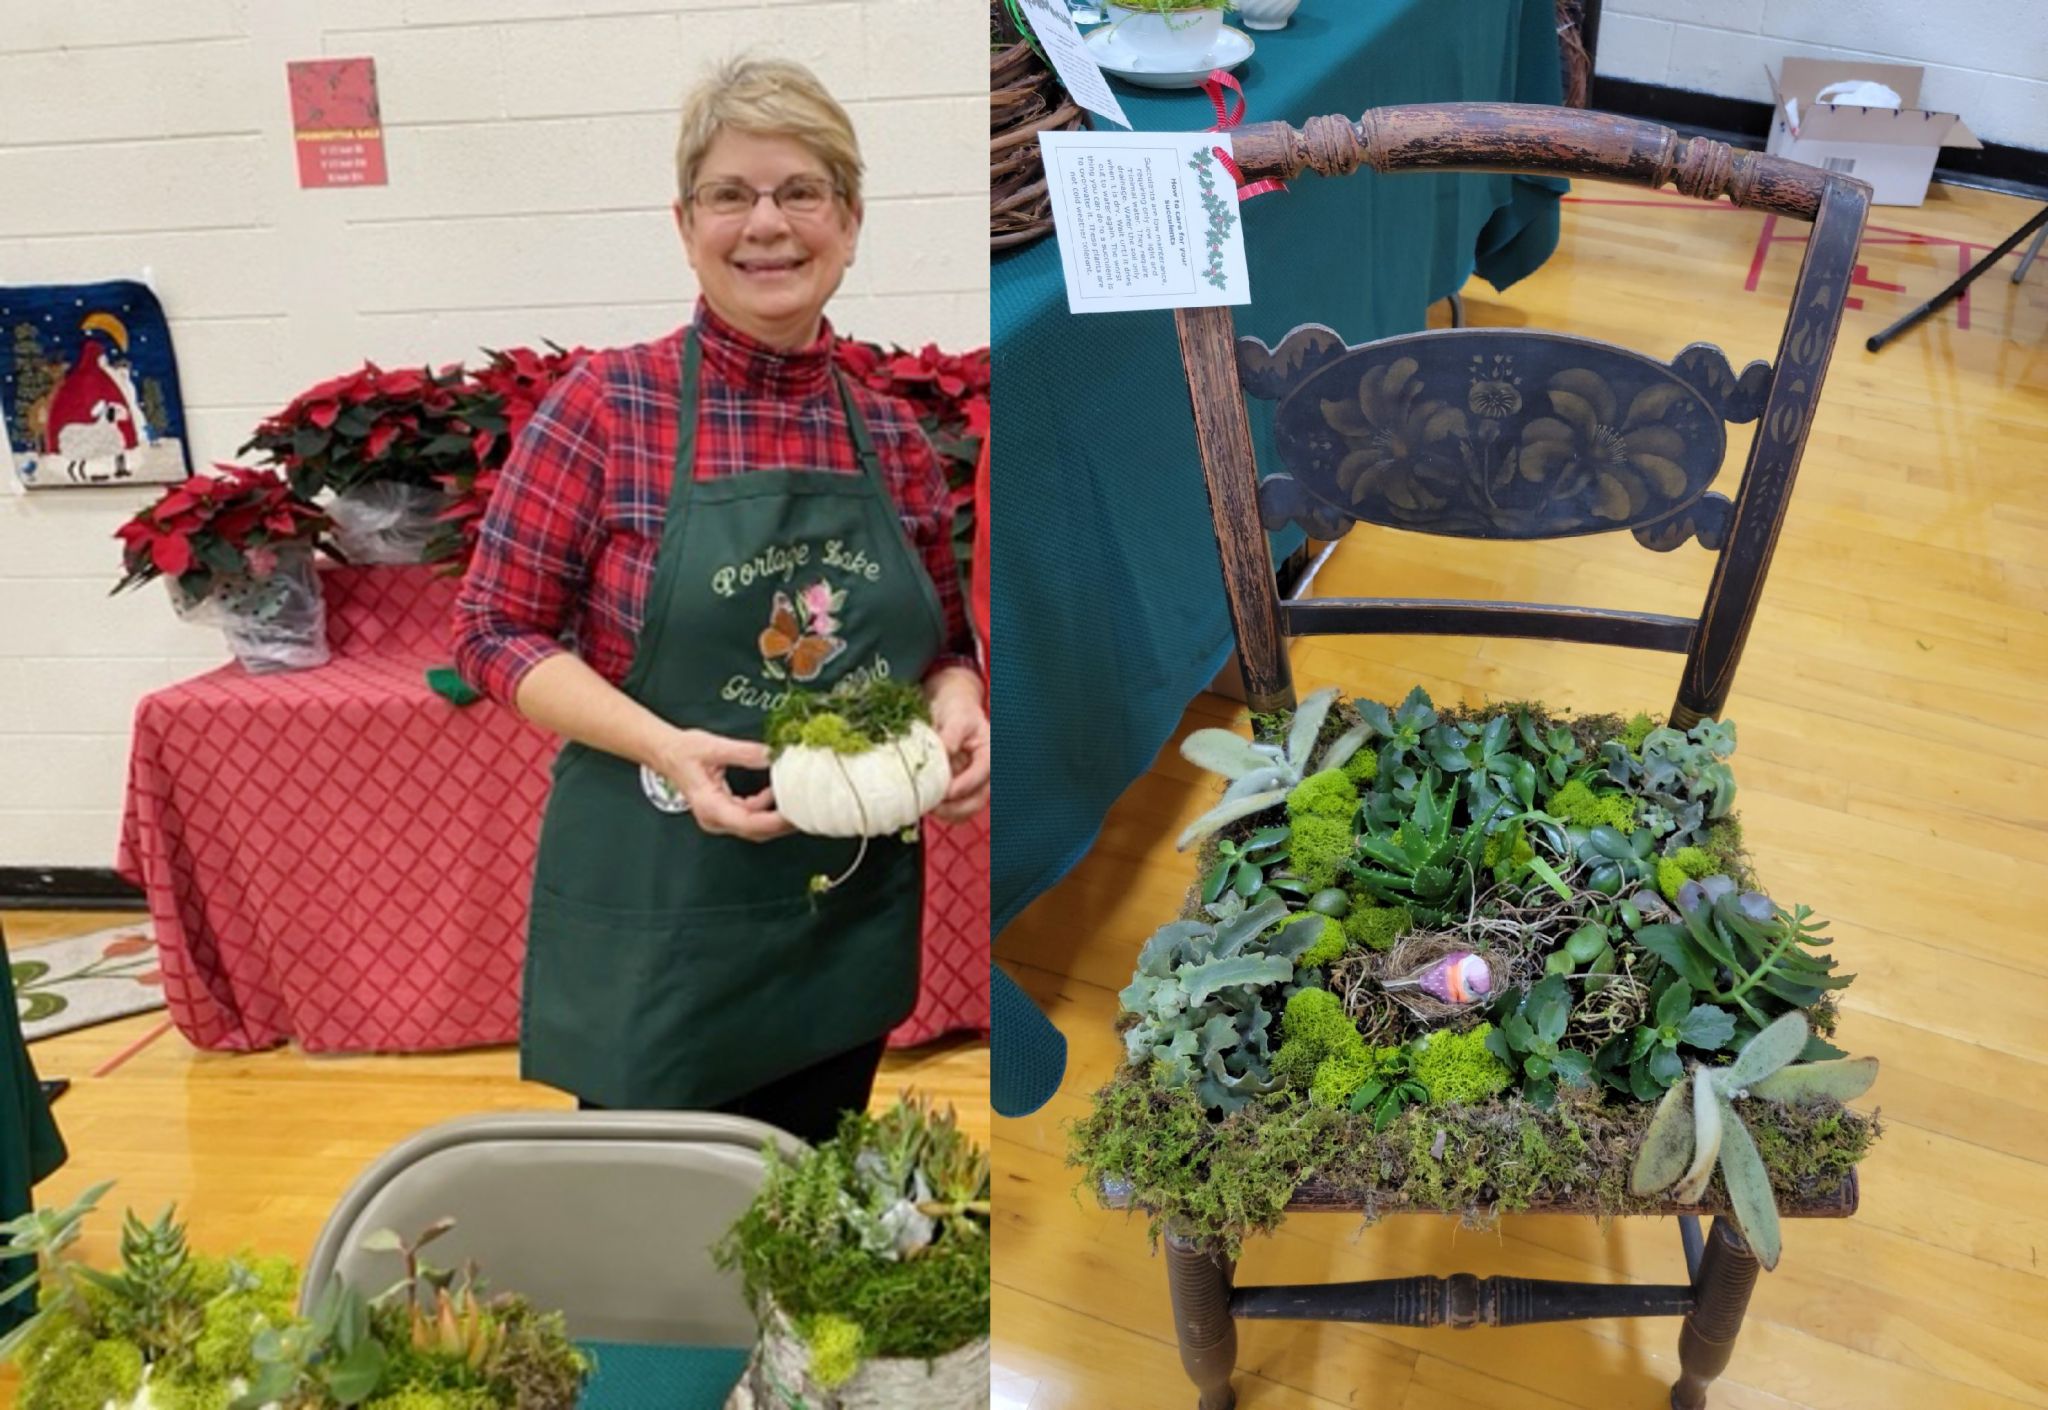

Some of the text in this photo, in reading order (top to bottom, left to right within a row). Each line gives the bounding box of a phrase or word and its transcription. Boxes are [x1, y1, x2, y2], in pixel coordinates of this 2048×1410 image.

[1135, 168, 1147, 204] requiring
[1079, 168, 1091, 209] overwater
[1091, 249, 1102, 273] plants
[1086, 155, 1095, 176] thing
[1100, 243, 1112, 280] succulent
[1102, 190, 1111, 214] water
[1113, 259, 1122, 281] worst
[1106, 159, 1115, 180] when
[1116, 219, 1125, 237] Wait
[1123, 267, 1133, 286] dries
[1123, 206, 1133, 230] Water
[1135, 229, 1145, 247] They
[1164, 199, 1176, 245] succulents
[1170, 178, 1178, 197] How
[1179, 247, 1187, 266] your
[712, 540, 880, 597] Portage Lake
[721, 675, 791, 711] Gard
